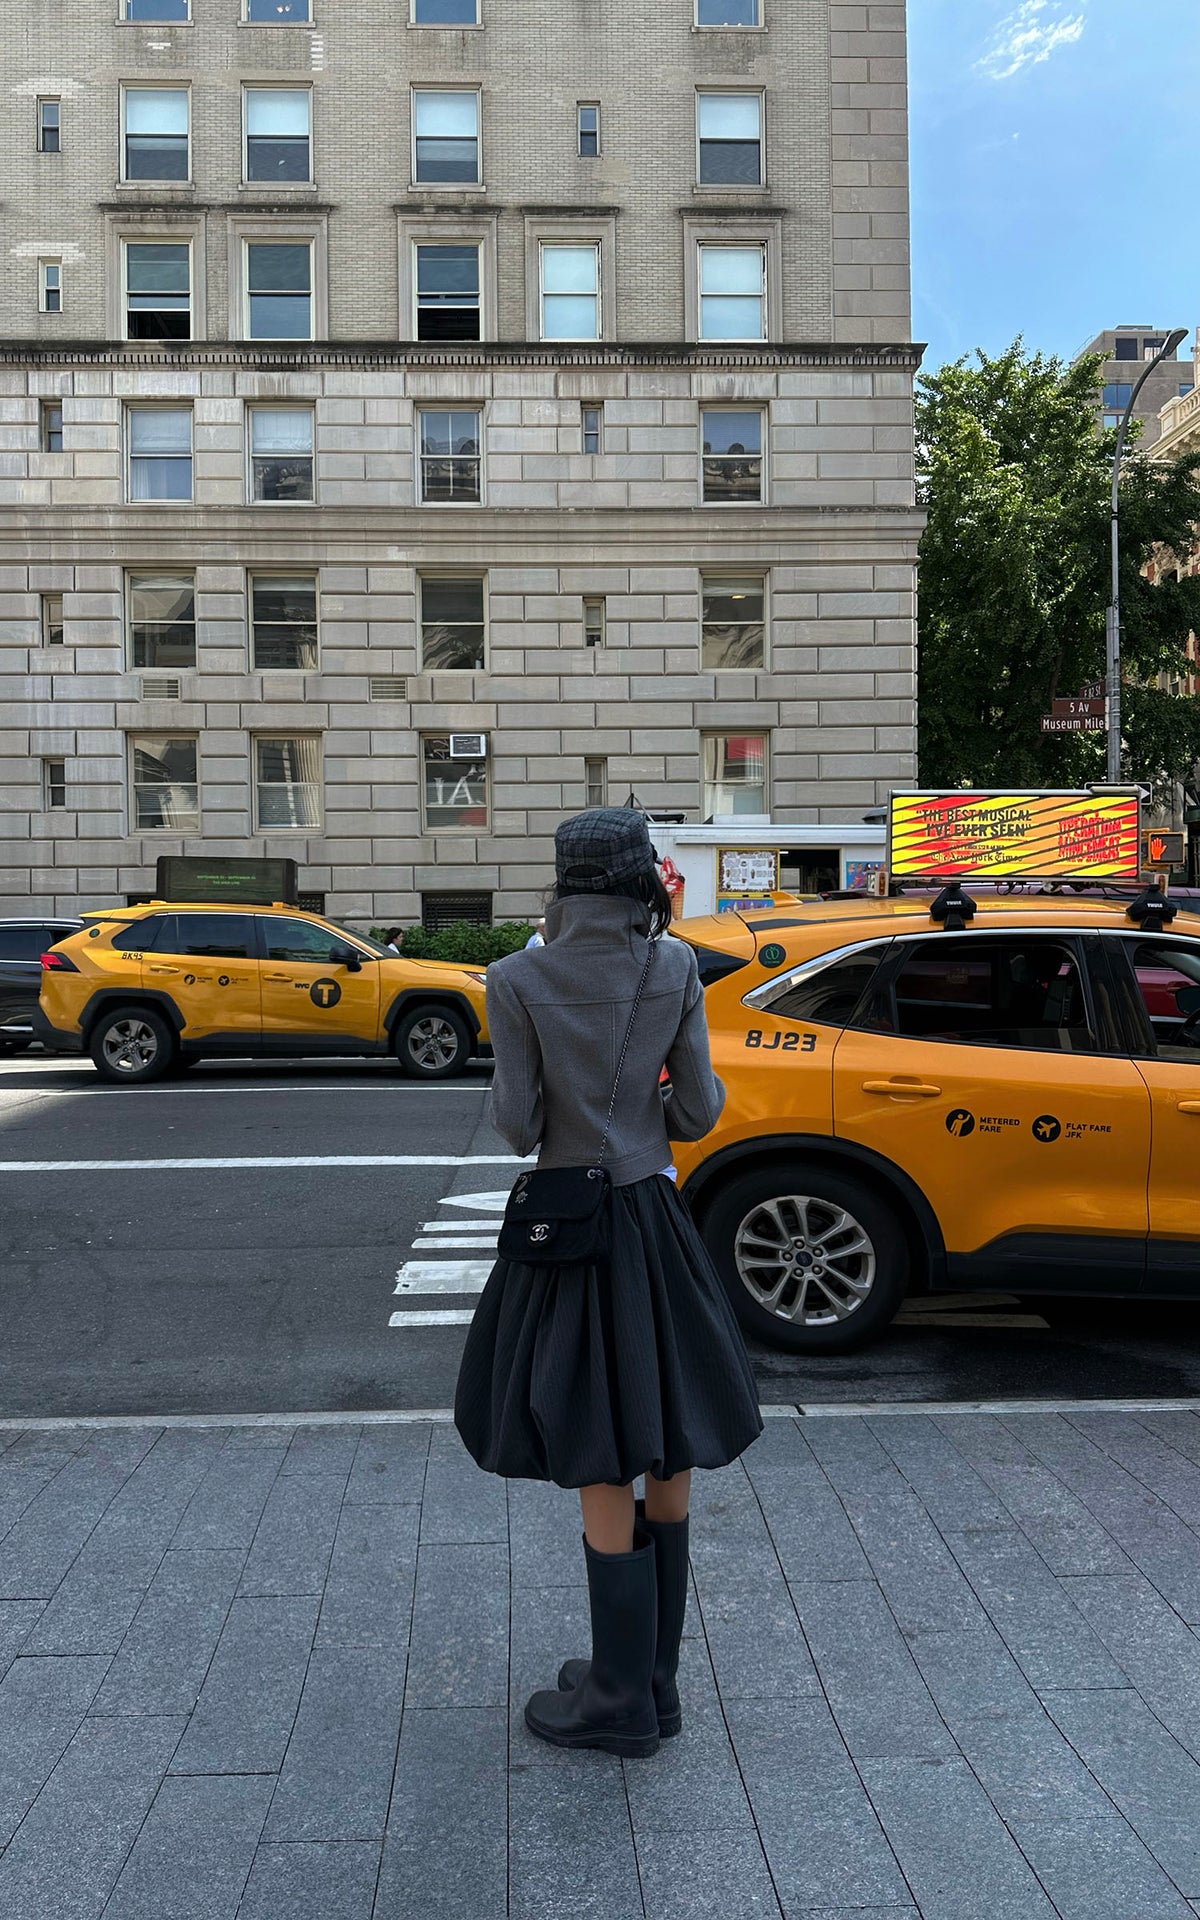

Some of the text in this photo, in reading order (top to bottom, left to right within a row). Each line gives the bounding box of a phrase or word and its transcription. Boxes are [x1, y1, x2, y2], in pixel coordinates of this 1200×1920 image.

[1069, 702, 1090, 713] 5 Av
[1043, 717, 1104, 730] Museum Mile
[948, 808, 976, 821] BEST
[979, 808, 1032, 821] MUSICAL
[954, 823, 988, 837] EVER
[745, 1029, 817, 1052] 8J23
[979, 1116, 1021, 1126] METERED
[979, 1125, 1002, 1133] FARE
[1065, 1122, 1112, 1133] FLAT FARE
[1065, 1131, 1082, 1139] JFK
